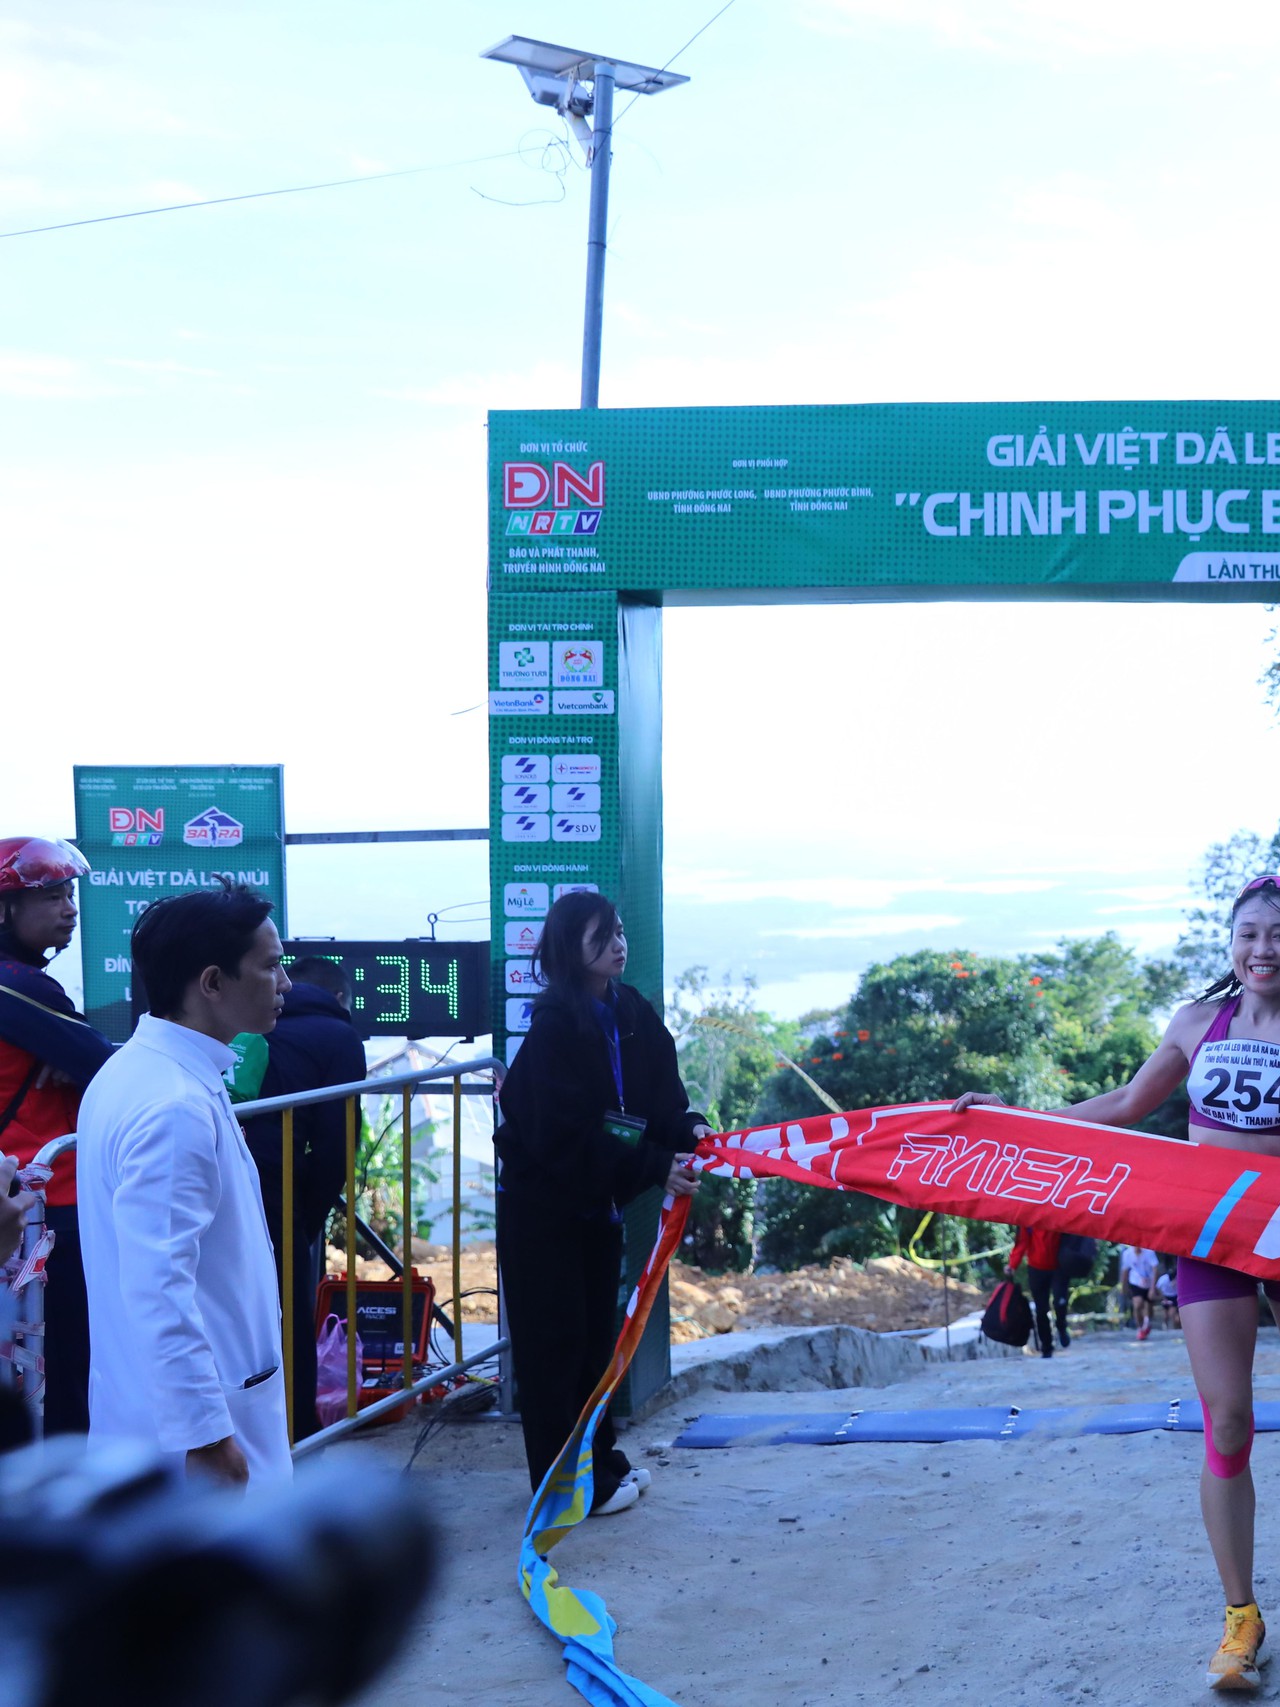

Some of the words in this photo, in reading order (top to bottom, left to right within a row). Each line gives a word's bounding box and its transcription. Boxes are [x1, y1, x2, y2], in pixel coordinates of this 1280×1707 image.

[520, 442, 539, 453] ĐƠN
[541, 443, 550, 455] VỊ
[552, 440, 563, 453] TỔ
[565, 441, 588, 452] CHỨC
[987, 425, 1066, 467] GIẢI
[1074, 426, 1168, 472] VIỆT
[1176, 426, 1243, 466] DÃ
[648, 491, 670, 501] UBND
[671, 490, 705, 500] PHƯỜNG
[706, 489, 732, 499] PHƯỚC
[734, 489, 757, 500] LONG,
[764, 489, 787, 499] UBND
[788, 487, 822, 498] PHƯỜNG
[823, 486, 849, 497] PHƯỚC
[851, 486, 874, 497] BÌNH,
[673, 502, 692, 513] TỈNH
[717, 504, 731, 512] NAI
[790, 500, 809, 511] TỈNH
[834, 501, 848, 510] NAI
[511, 514, 597, 531] NRTV
[1100, 491, 1250, 542] PHỤC
[509, 547, 527, 558] BÁO
[529, 547, 540, 558] VÀ
[542, 548, 565, 558] PHÁT
[567, 548, 600, 559] THANH,
[503, 562, 537, 573] TRUYỀN
[539, 562, 561, 573] HÌNH
[563, 560, 588, 573] ĐỒNG
[590, 563, 606, 573] NAI
[1207, 560, 1246, 579] LẦN
[582, 674, 596, 682] NAI
[494, 699, 534, 707] VietinBank
[558, 702, 608, 710] Vietcombank
[575, 825, 597, 833] SDV
[89, 868, 124, 886] GIẢI
[127, 868, 167, 889] VIỆT
[170, 869, 198, 886] DÃ
[201, 872, 235, 887] LEO
[238, 868, 269, 885] NÚI
[105, 954, 133, 973] ĐỈN
[1231, 1043, 1241, 1052] LEO
[1226, 1111, 1239, 1125] HỘI
[1245, 1115, 1273, 1126] THANH
[887, 1133, 1131, 1215] FINISH
